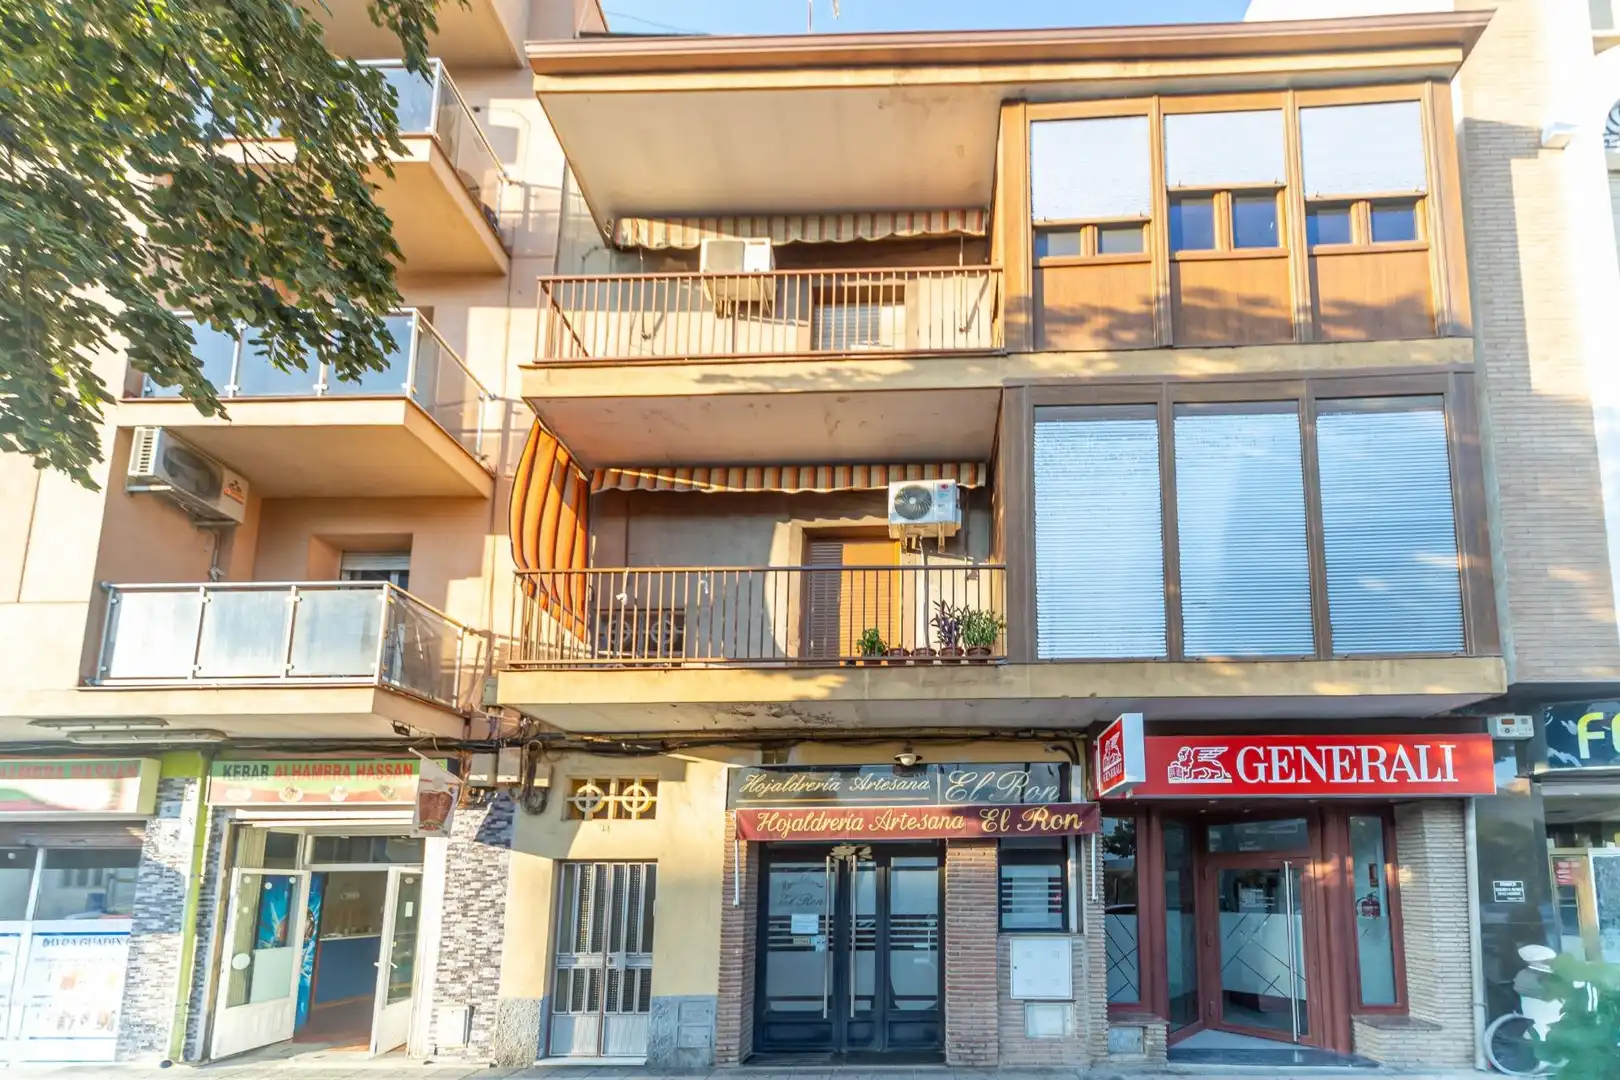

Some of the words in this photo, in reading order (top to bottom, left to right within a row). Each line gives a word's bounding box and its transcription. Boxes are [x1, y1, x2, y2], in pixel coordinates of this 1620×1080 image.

[223, 764, 270, 781] KEBAB
[274, 764, 351, 781] ALHAMBRA
[356, 763, 413, 780] HASSAN
[1236, 744, 1459, 783] GENERALI
[739, 773, 842, 798] Hojaldrería
[849, 772, 931, 792] Artesana
[945, 770, 996, 802] El
[989, 770, 1061, 802] Ron
[756, 811, 865, 839] Hojaldrería
[868, 808, 965, 832] Artesana
[979, 808, 1011, 832] El
[1016, 805, 1083, 832] Ron
